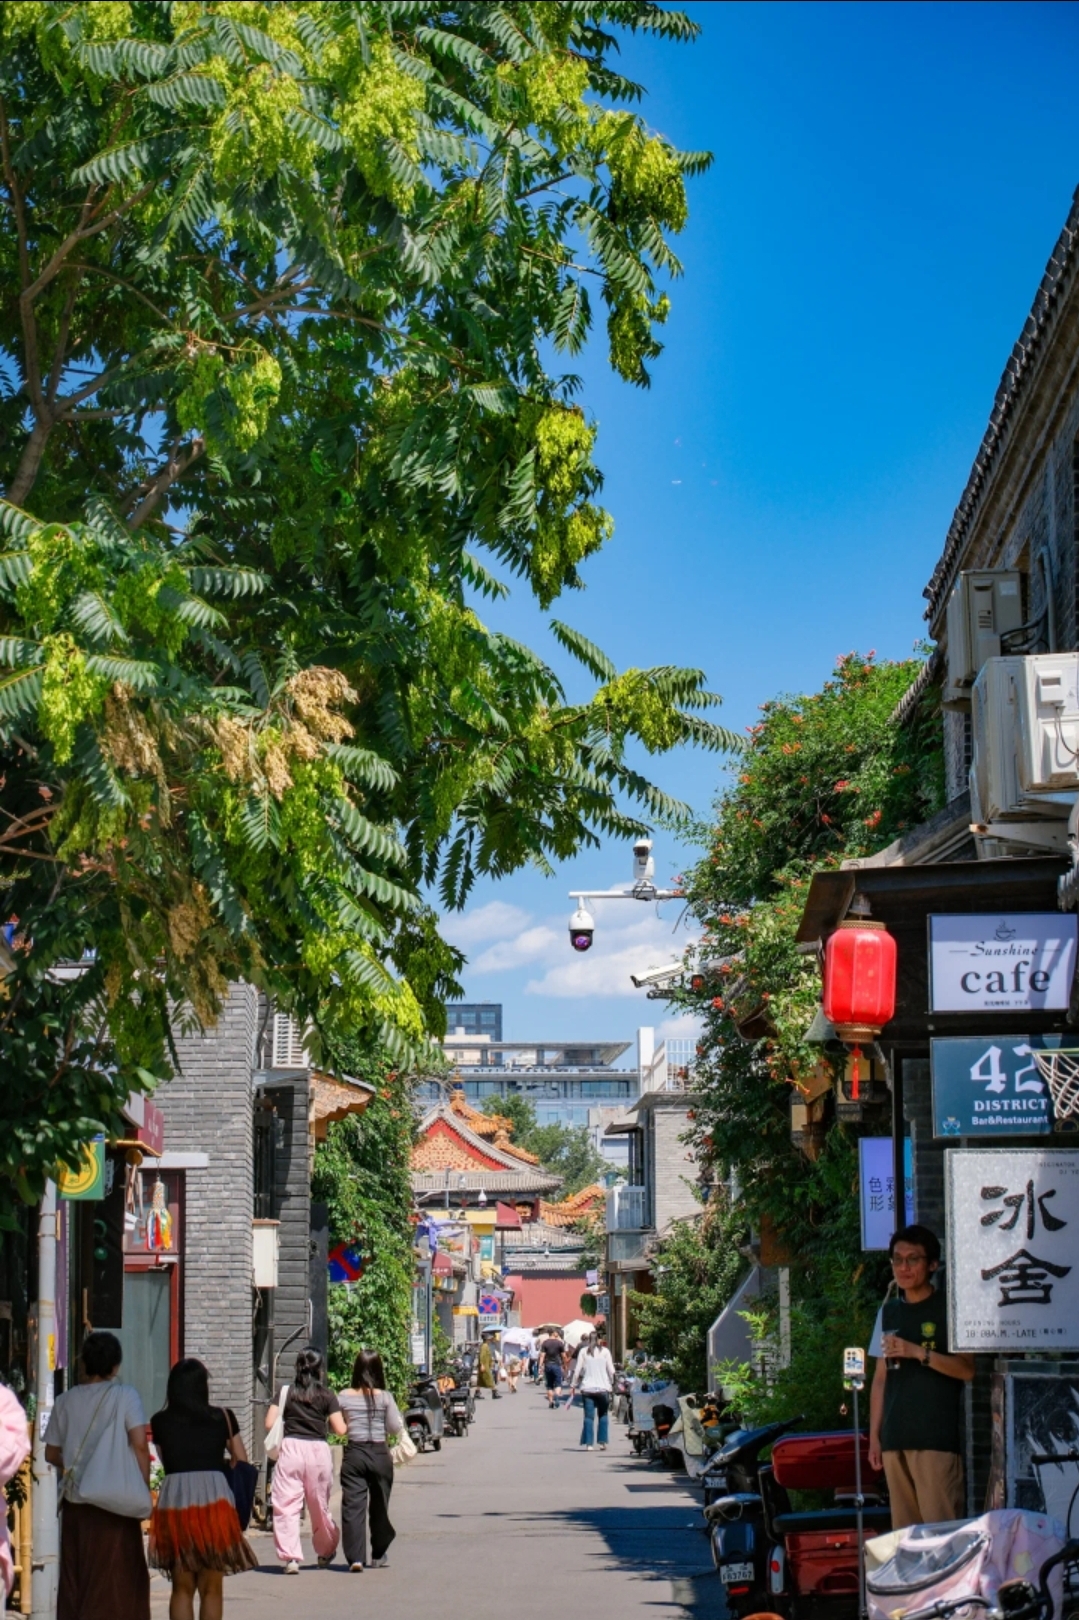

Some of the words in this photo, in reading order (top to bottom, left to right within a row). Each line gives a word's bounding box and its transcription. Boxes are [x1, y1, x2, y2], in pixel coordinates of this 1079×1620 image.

[970, 941, 1038, 957] Sunshine
[960, 960, 1050, 994] cafe
[974, 1098, 1047, 1112] DISTRICT
[971, 1115, 1048, 1126] Bar&Restaurant
[980, 1179, 1072, 1307] 冰舍
